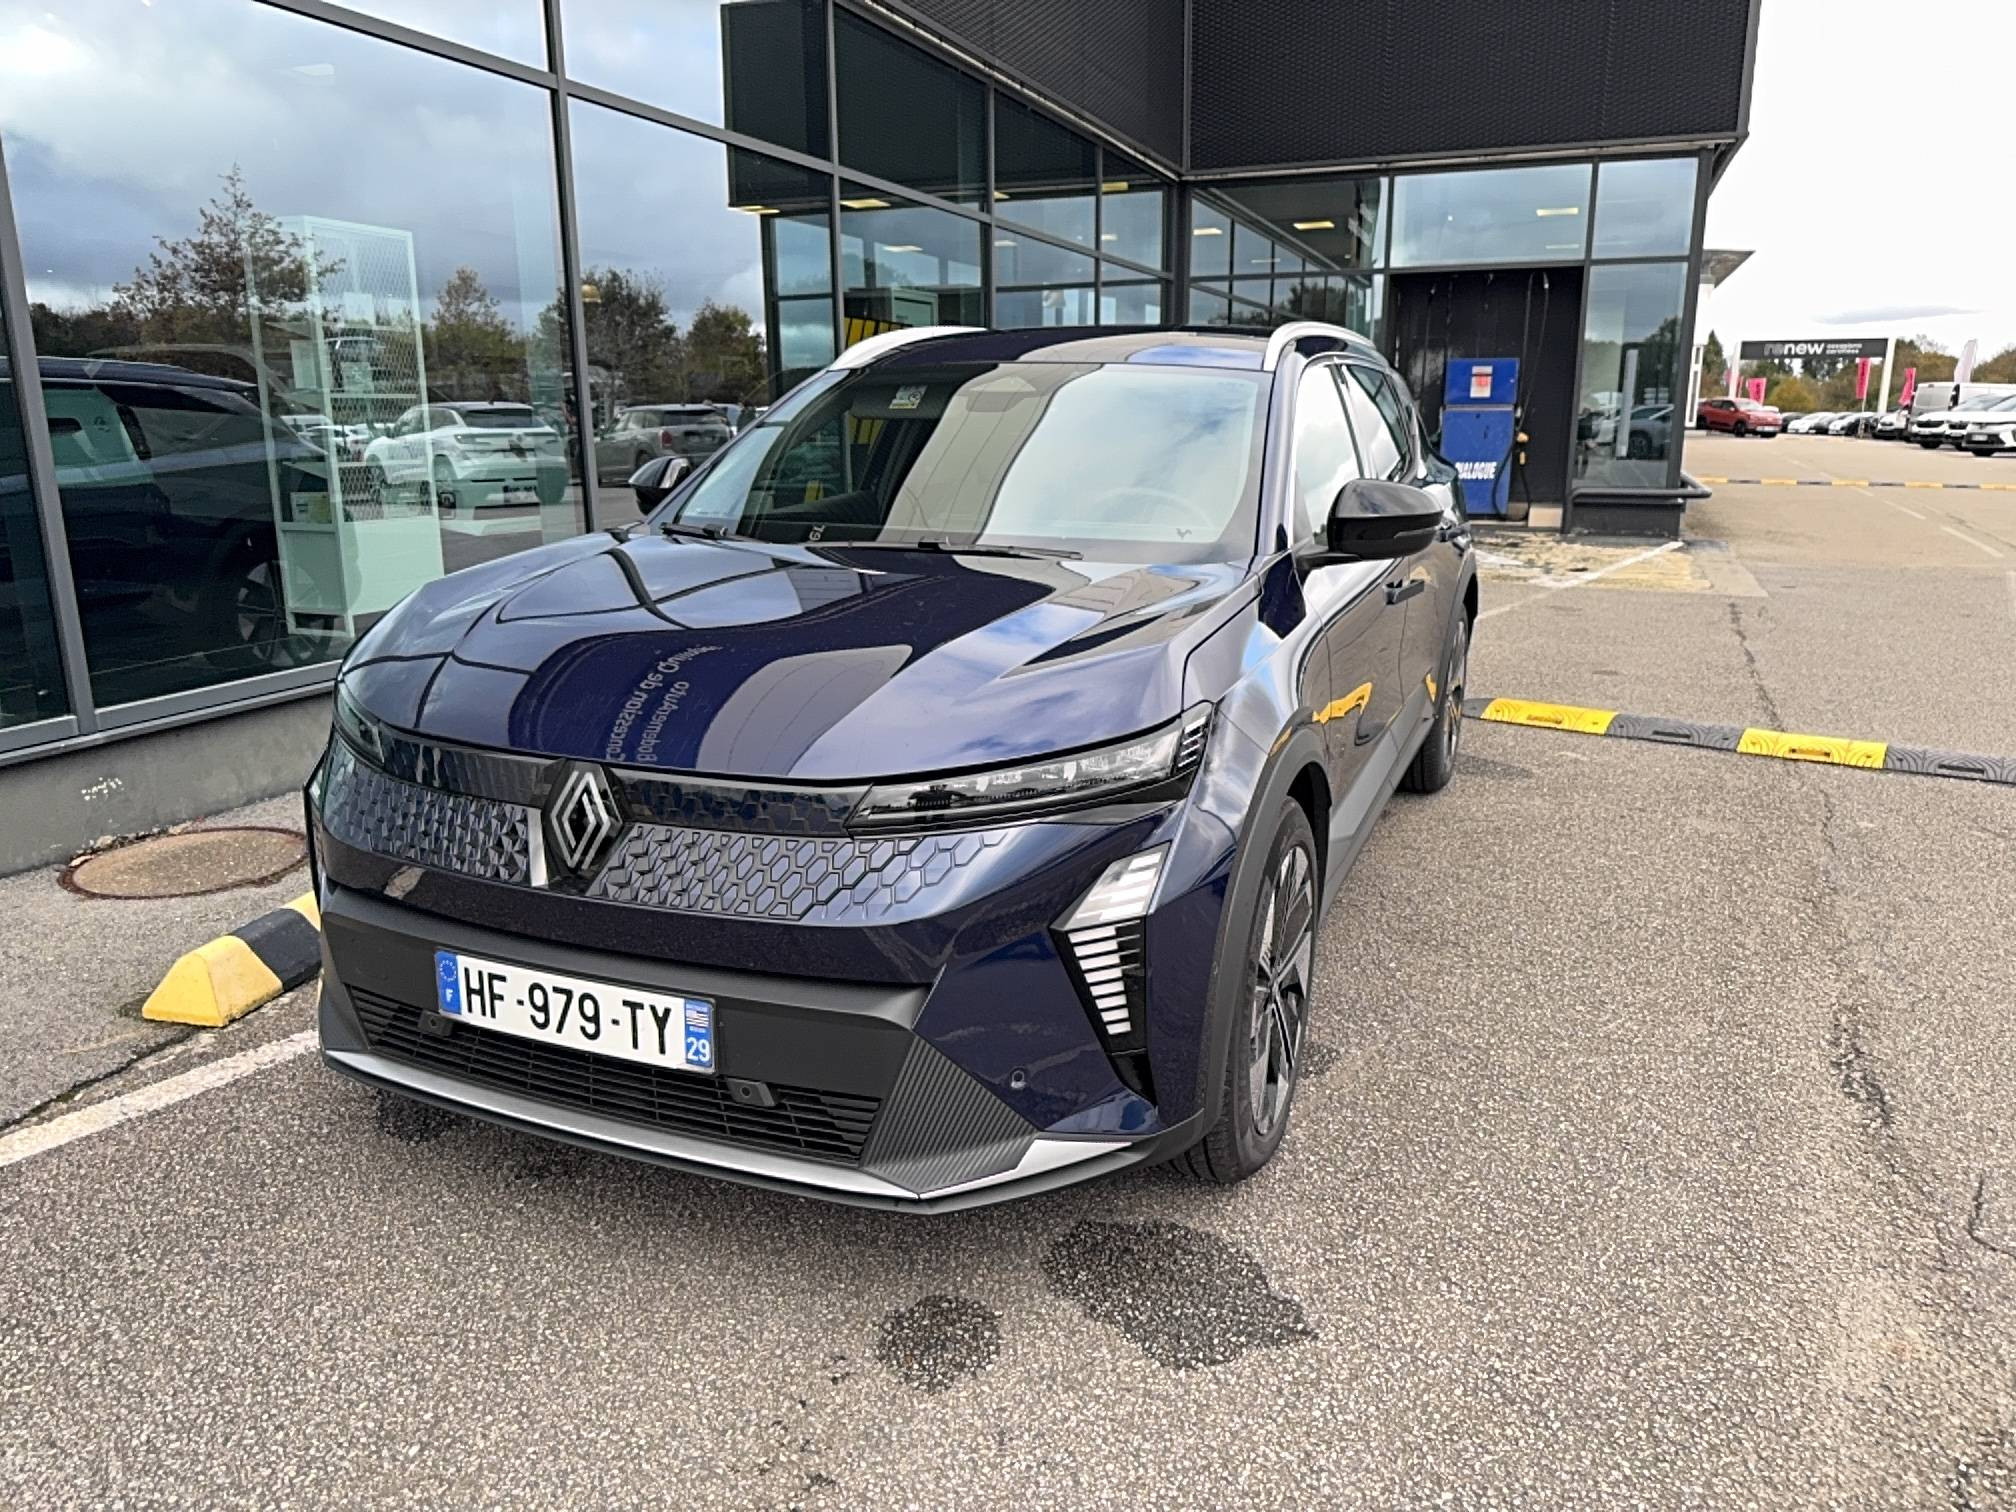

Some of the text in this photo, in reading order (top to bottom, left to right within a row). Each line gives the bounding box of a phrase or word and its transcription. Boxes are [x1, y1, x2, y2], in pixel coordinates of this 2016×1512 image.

[1764, 342, 1824, 356] renew
[445, 988, 454, 1003] F
[463, 967, 672, 1055] HF-979-TY
[687, 1036, 710, 1062] 29
